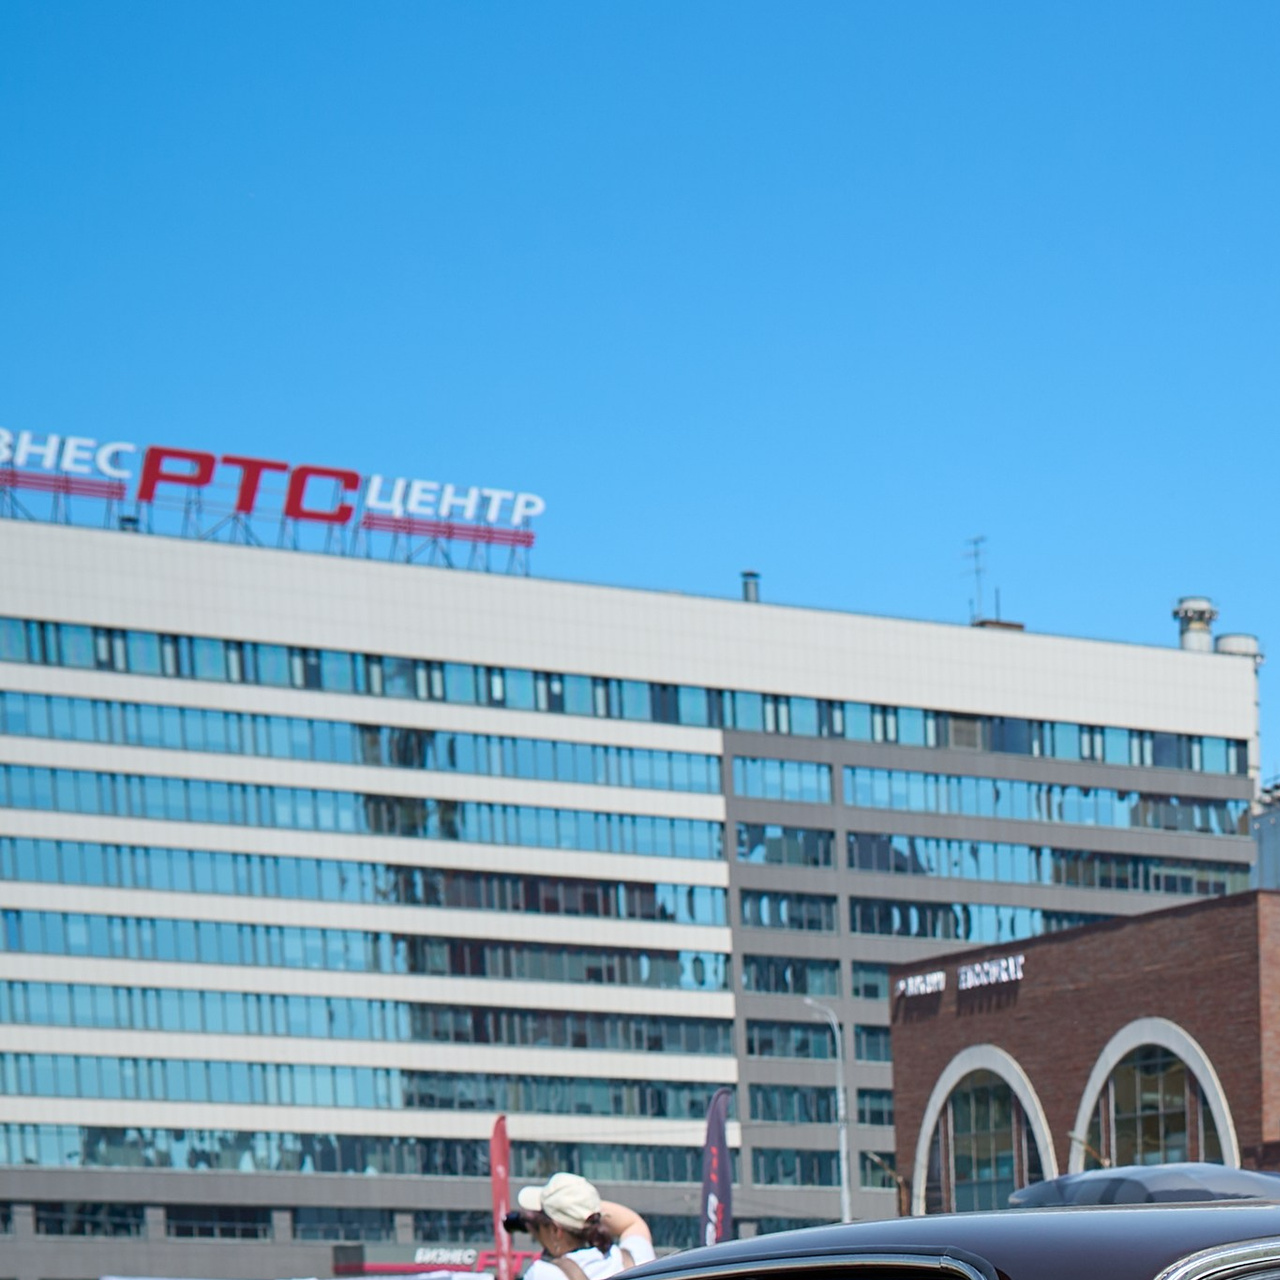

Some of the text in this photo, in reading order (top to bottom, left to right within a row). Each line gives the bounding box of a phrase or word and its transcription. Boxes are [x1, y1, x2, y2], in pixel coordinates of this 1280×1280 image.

[136, 445, 363, 524] РТС
[365, 473, 547, 527] ЦЕНТР
[475, 1250, 542, 1274] РТ
